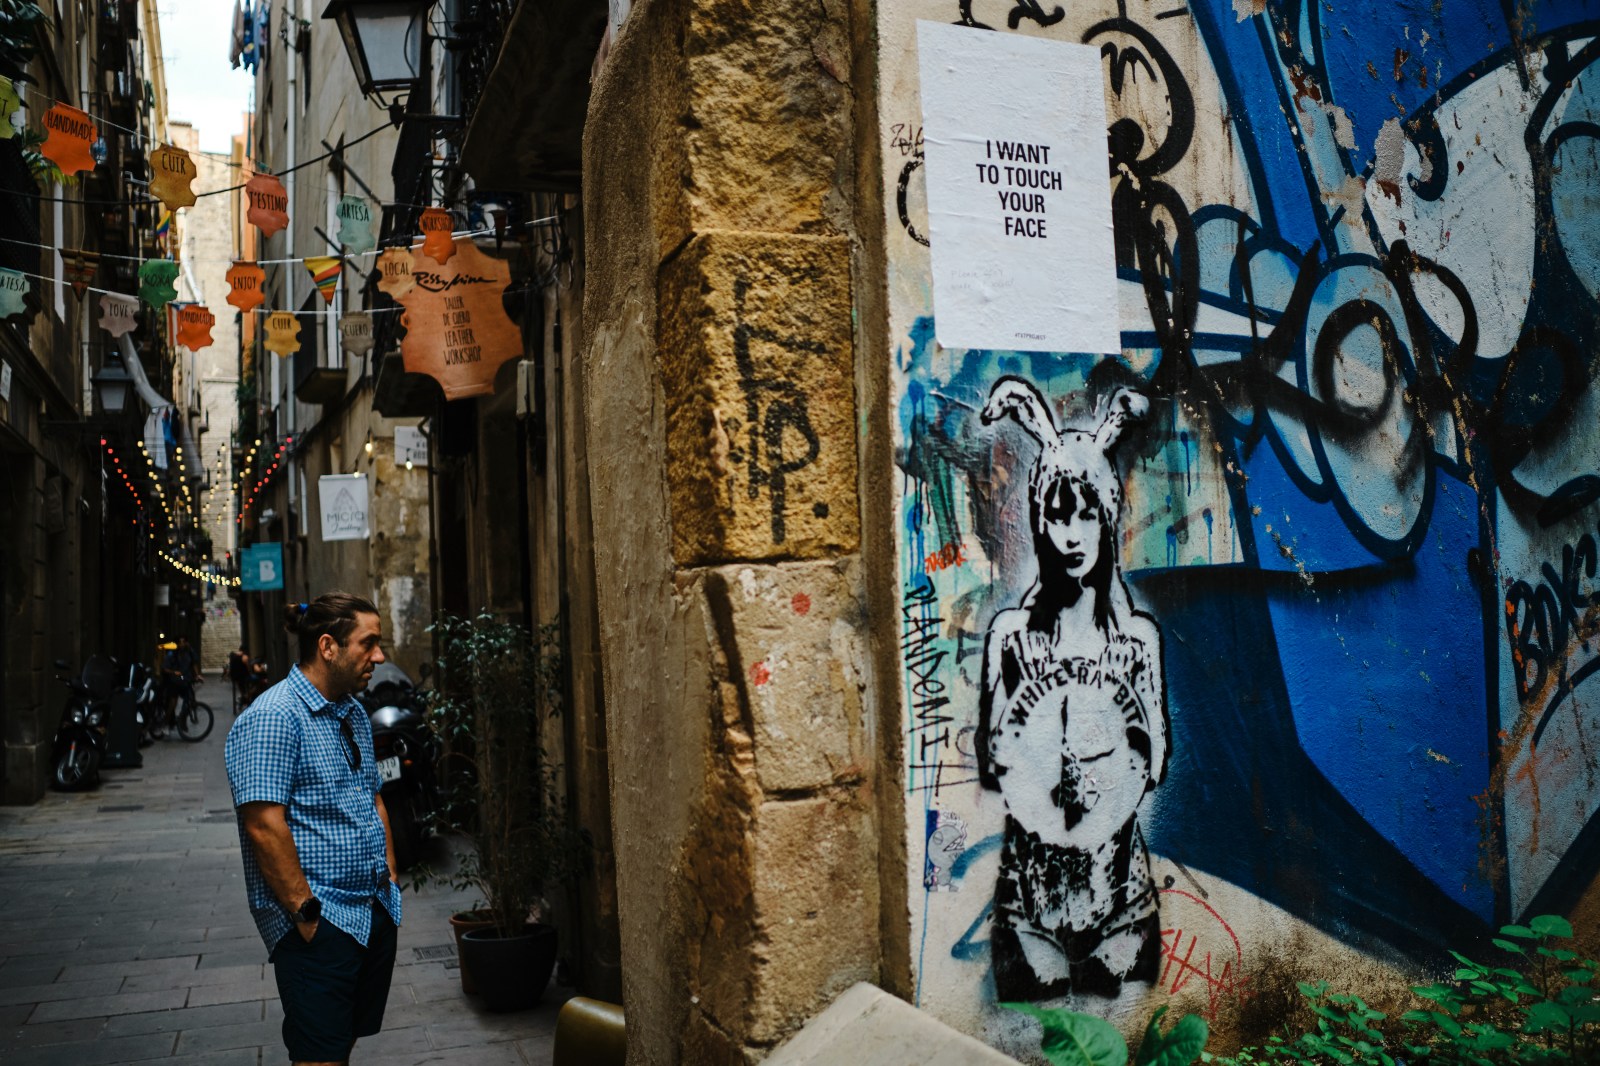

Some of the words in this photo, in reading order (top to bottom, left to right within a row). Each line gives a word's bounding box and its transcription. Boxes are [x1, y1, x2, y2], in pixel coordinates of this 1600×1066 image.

[47, 110, 93, 142] HANDMADE
[986, 140, 991, 159] I
[996, 141, 1051, 165] WANT
[162, 153, 186, 175] CUIR
[976, 163, 999, 185] TO
[1003, 166, 1063, 191] TOUCH
[249, 191, 287, 213] T'ESTIMO
[998, 191, 1046, 214] YOUR
[1004, 216, 1047, 239] FACE
[384, 261, 410, 276] LOCAL
[233, 276, 257, 291] ENJOY
[109, 303, 129, 318] LOVE
[443, 295, 465, 310] TALLER
[272, 317, 292, 330] CUIR
[443, 312, 451, 326] DE
[452, 310, 471, 325] CUERO
[344, 323, 369, 337] CUERO
[444, 328, 476, 347] LEATHER
[443, 346, 482, 365] WORKSHOP
[259, 560, 275, 582] B
[1008, 668, 1068, 726] WHITE
